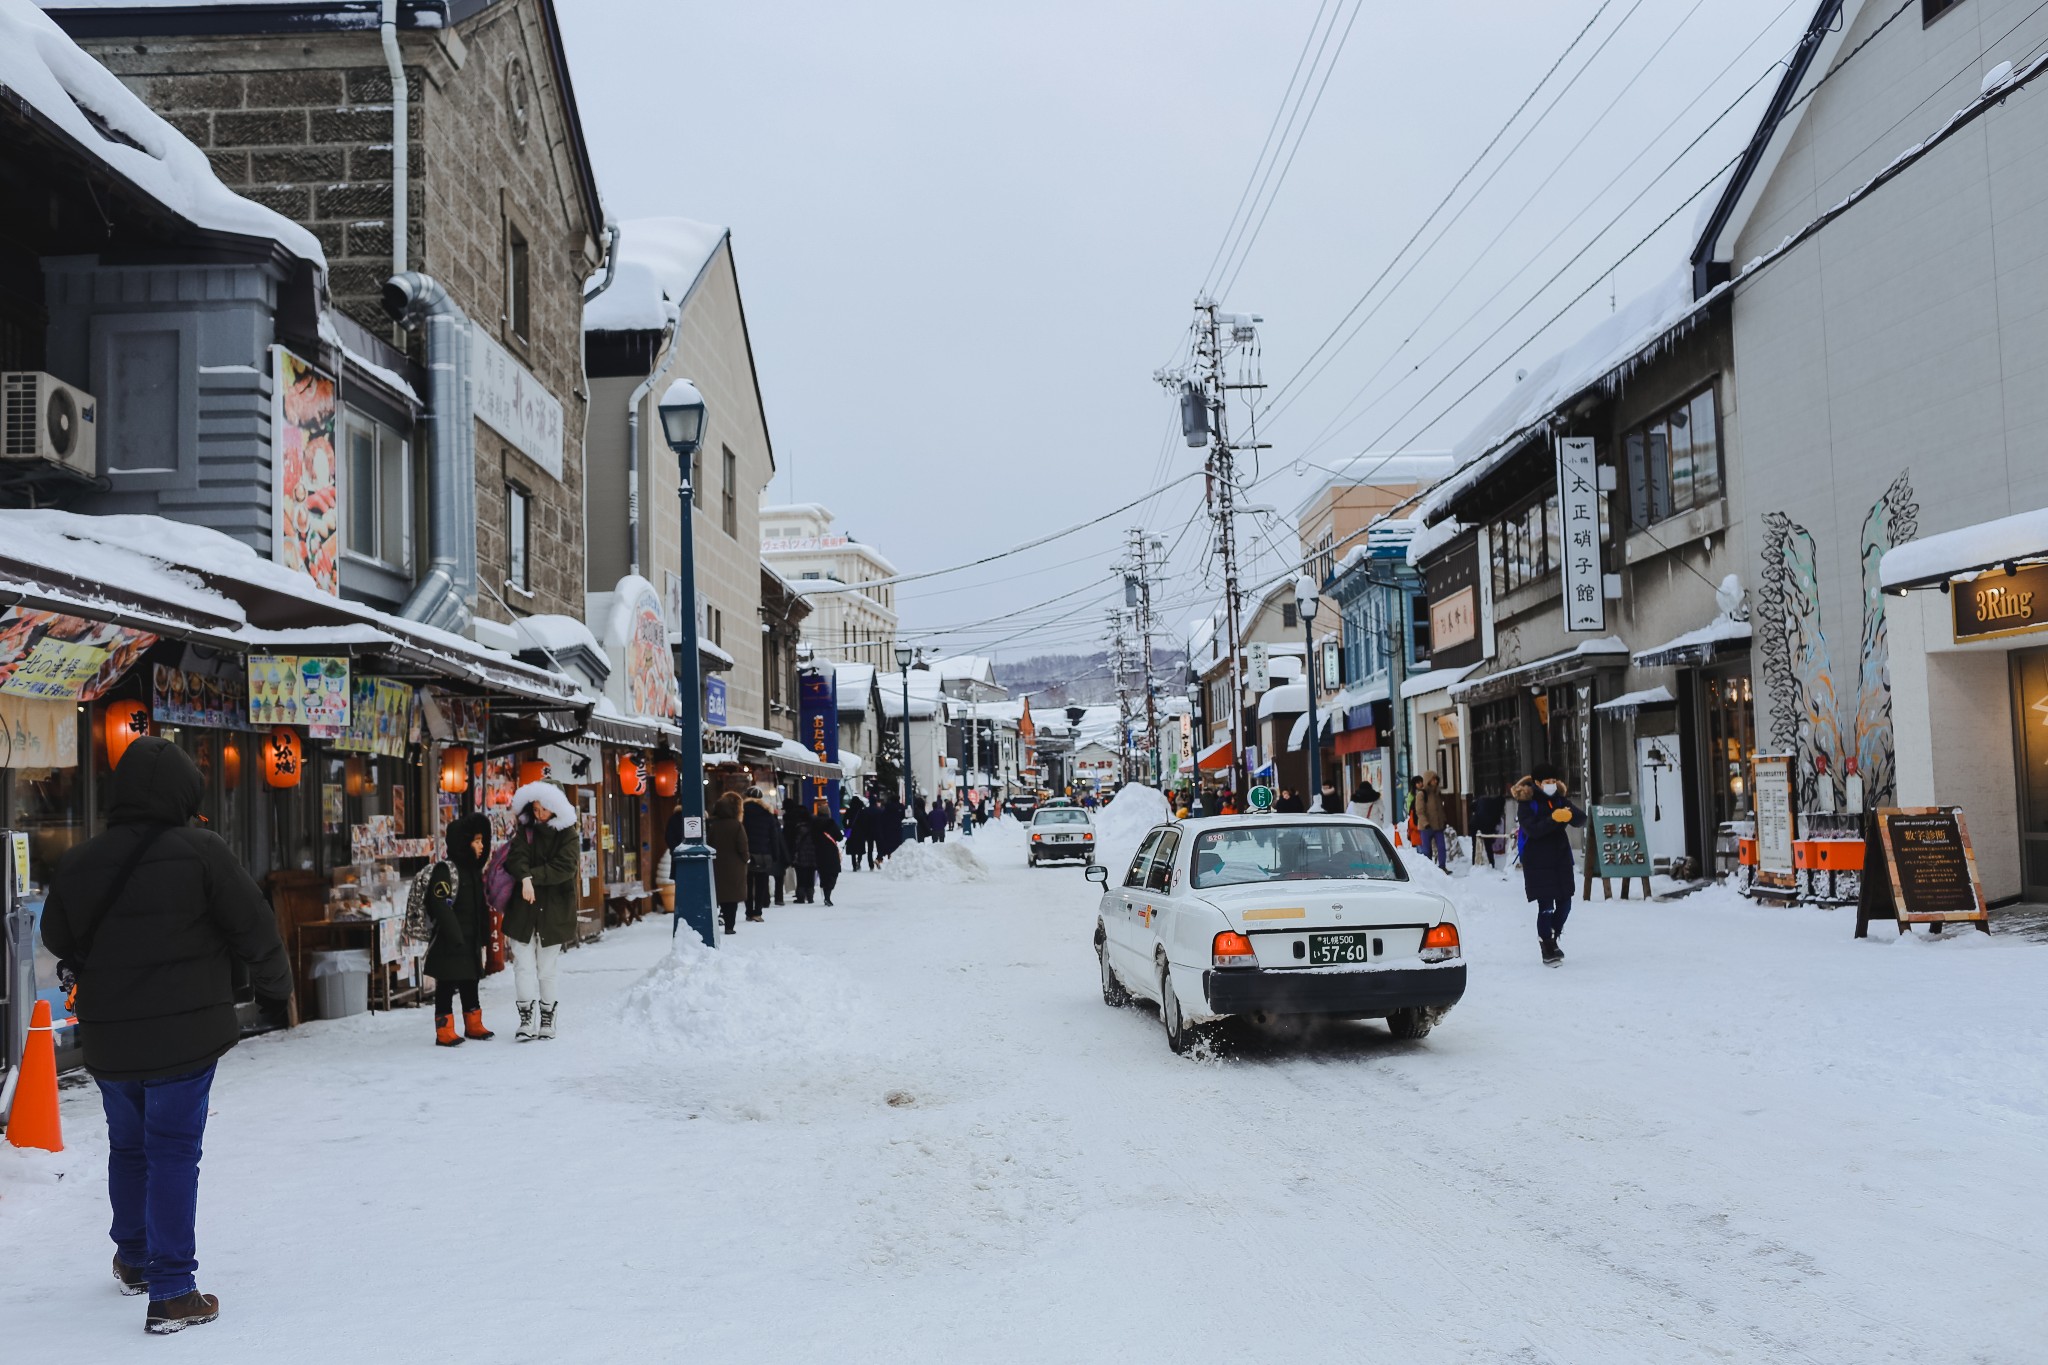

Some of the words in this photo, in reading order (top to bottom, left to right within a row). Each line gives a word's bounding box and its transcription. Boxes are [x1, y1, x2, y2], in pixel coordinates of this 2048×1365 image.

[1572, 476, 1595, 602] 大正硝子館
[1976, 587, 2033, 621] 3Ring
[1258, 788, 1266, 806] ミドリ
[1322, 944, 1365, 962] 57-60
